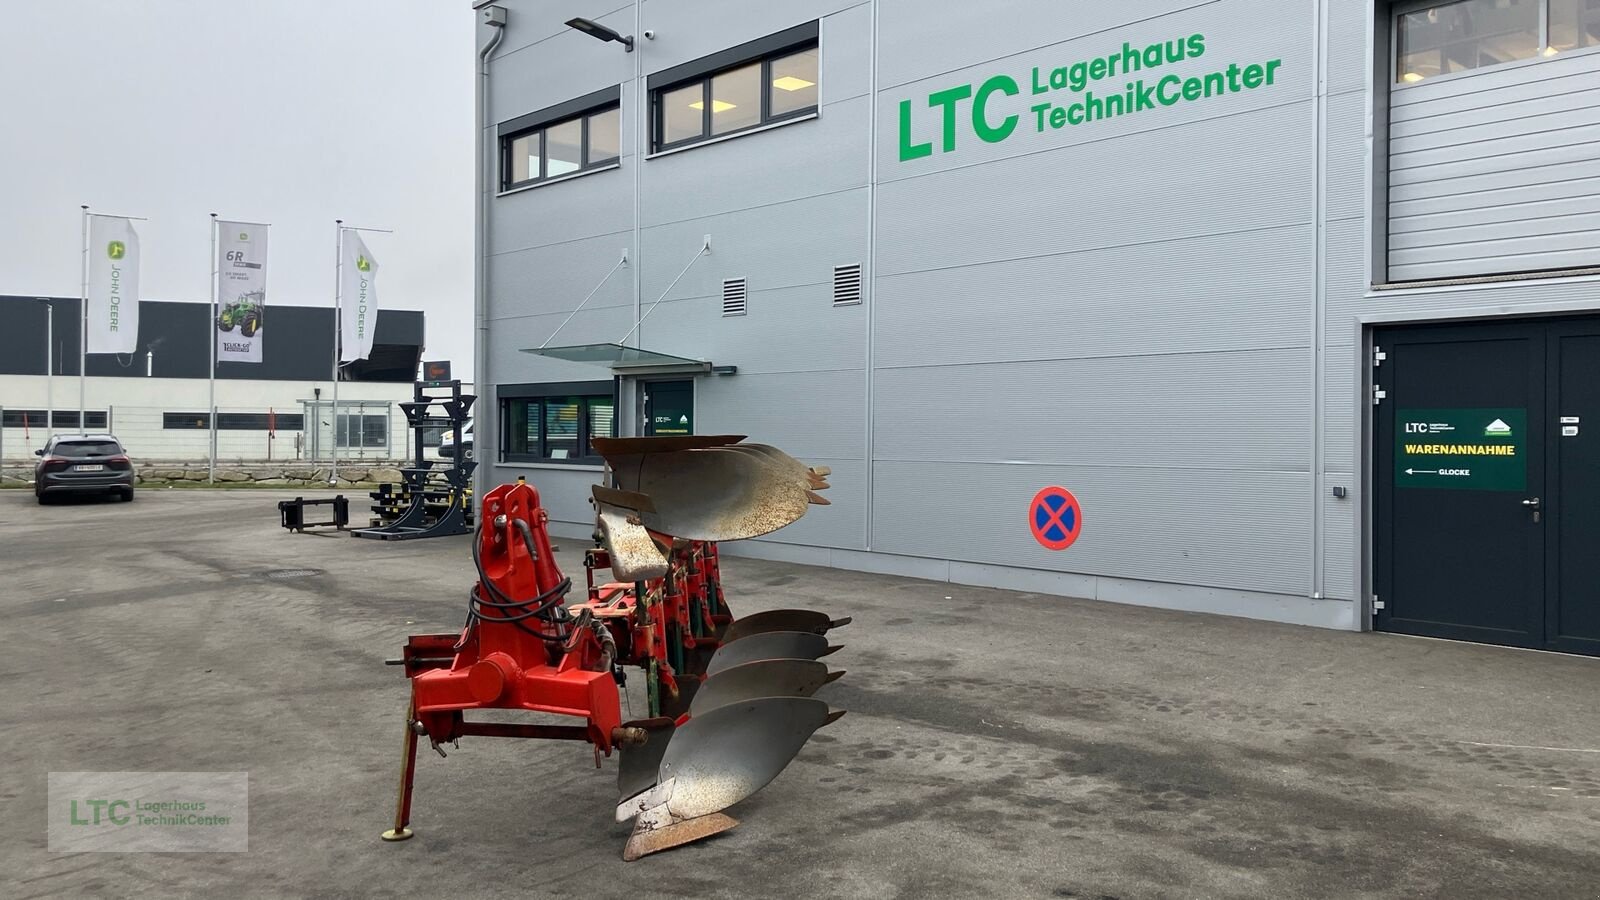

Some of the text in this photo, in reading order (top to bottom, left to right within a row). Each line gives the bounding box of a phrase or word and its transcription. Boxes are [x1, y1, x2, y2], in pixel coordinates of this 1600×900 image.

[1031, 59, 1282, 132] TechnikCenter
[1032, 33, 1206, 96] Lagerhaus
[899, 75, 1020, 162] LTC
[226, 250, 244, 262] 6R
[110, 264, 121, 333] JOHN DEERE
[358, 274, 368, 340] JOHN DEERE
[1405, 422, 1428, 433] LTC
[1405, 444, 1515, 456] WARENANNAHME
[1438, 468, 1470, 476] GLOCKE
